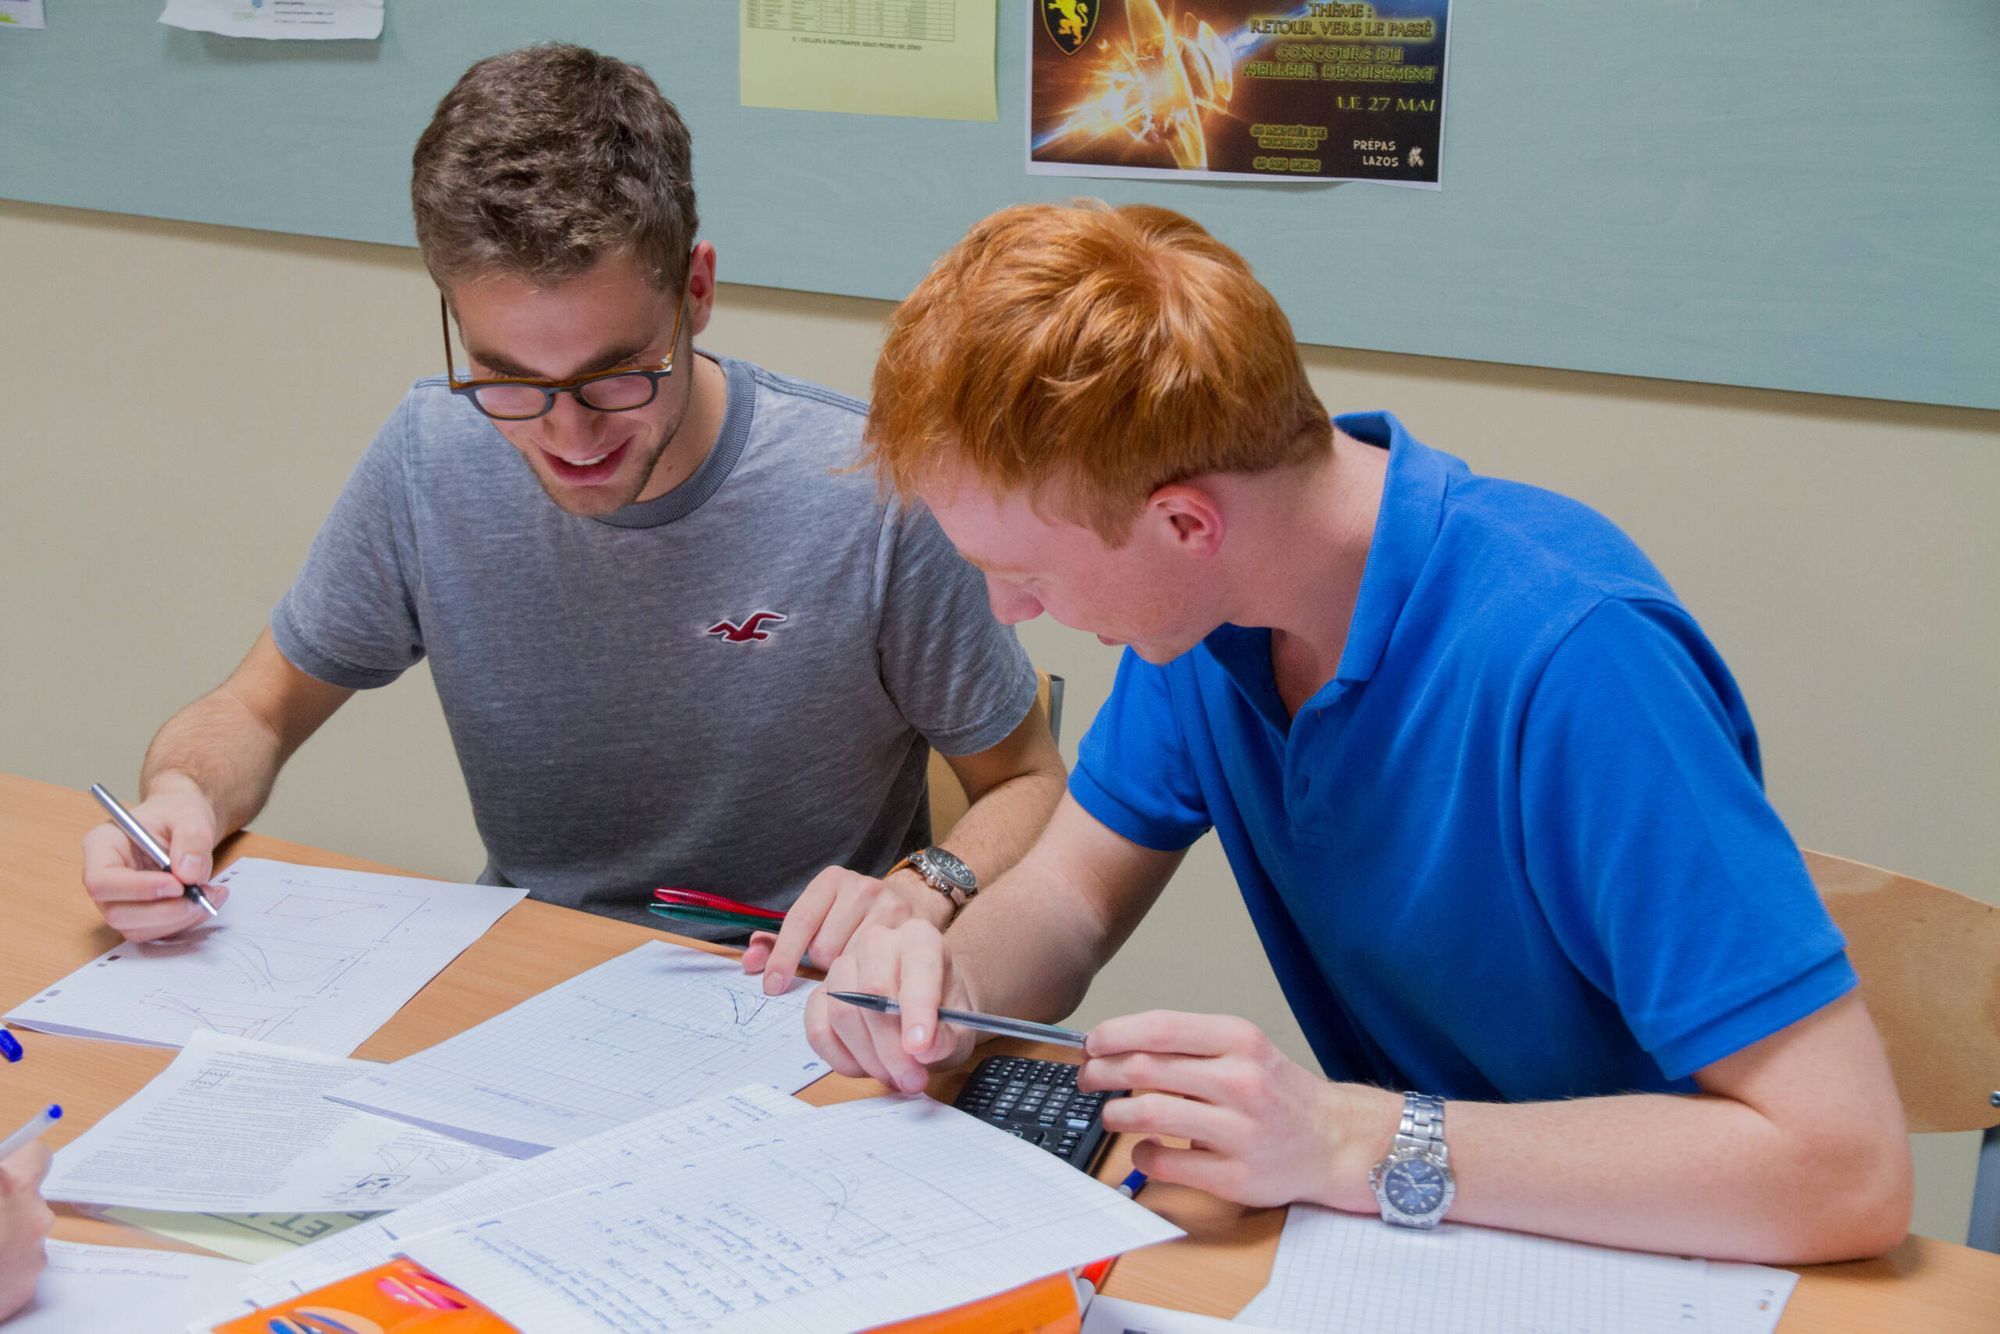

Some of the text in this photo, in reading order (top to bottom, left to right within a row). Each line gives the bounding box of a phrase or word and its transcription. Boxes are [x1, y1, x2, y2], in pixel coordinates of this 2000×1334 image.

[1250, 19, 1433, 38] RETOUR VERS LE PASSÉ
[1275, 45, 1404, 64] CONCOURS DU
[1243, 61, 1438, 82] MEILLEUR DÉGUISEMENT
[1336, 96, 1436, 112] LE 27 MAI
[1353, 138, 1397, 151] PRÉPAS
[1363, 155, 1399, 168] LAZOS
